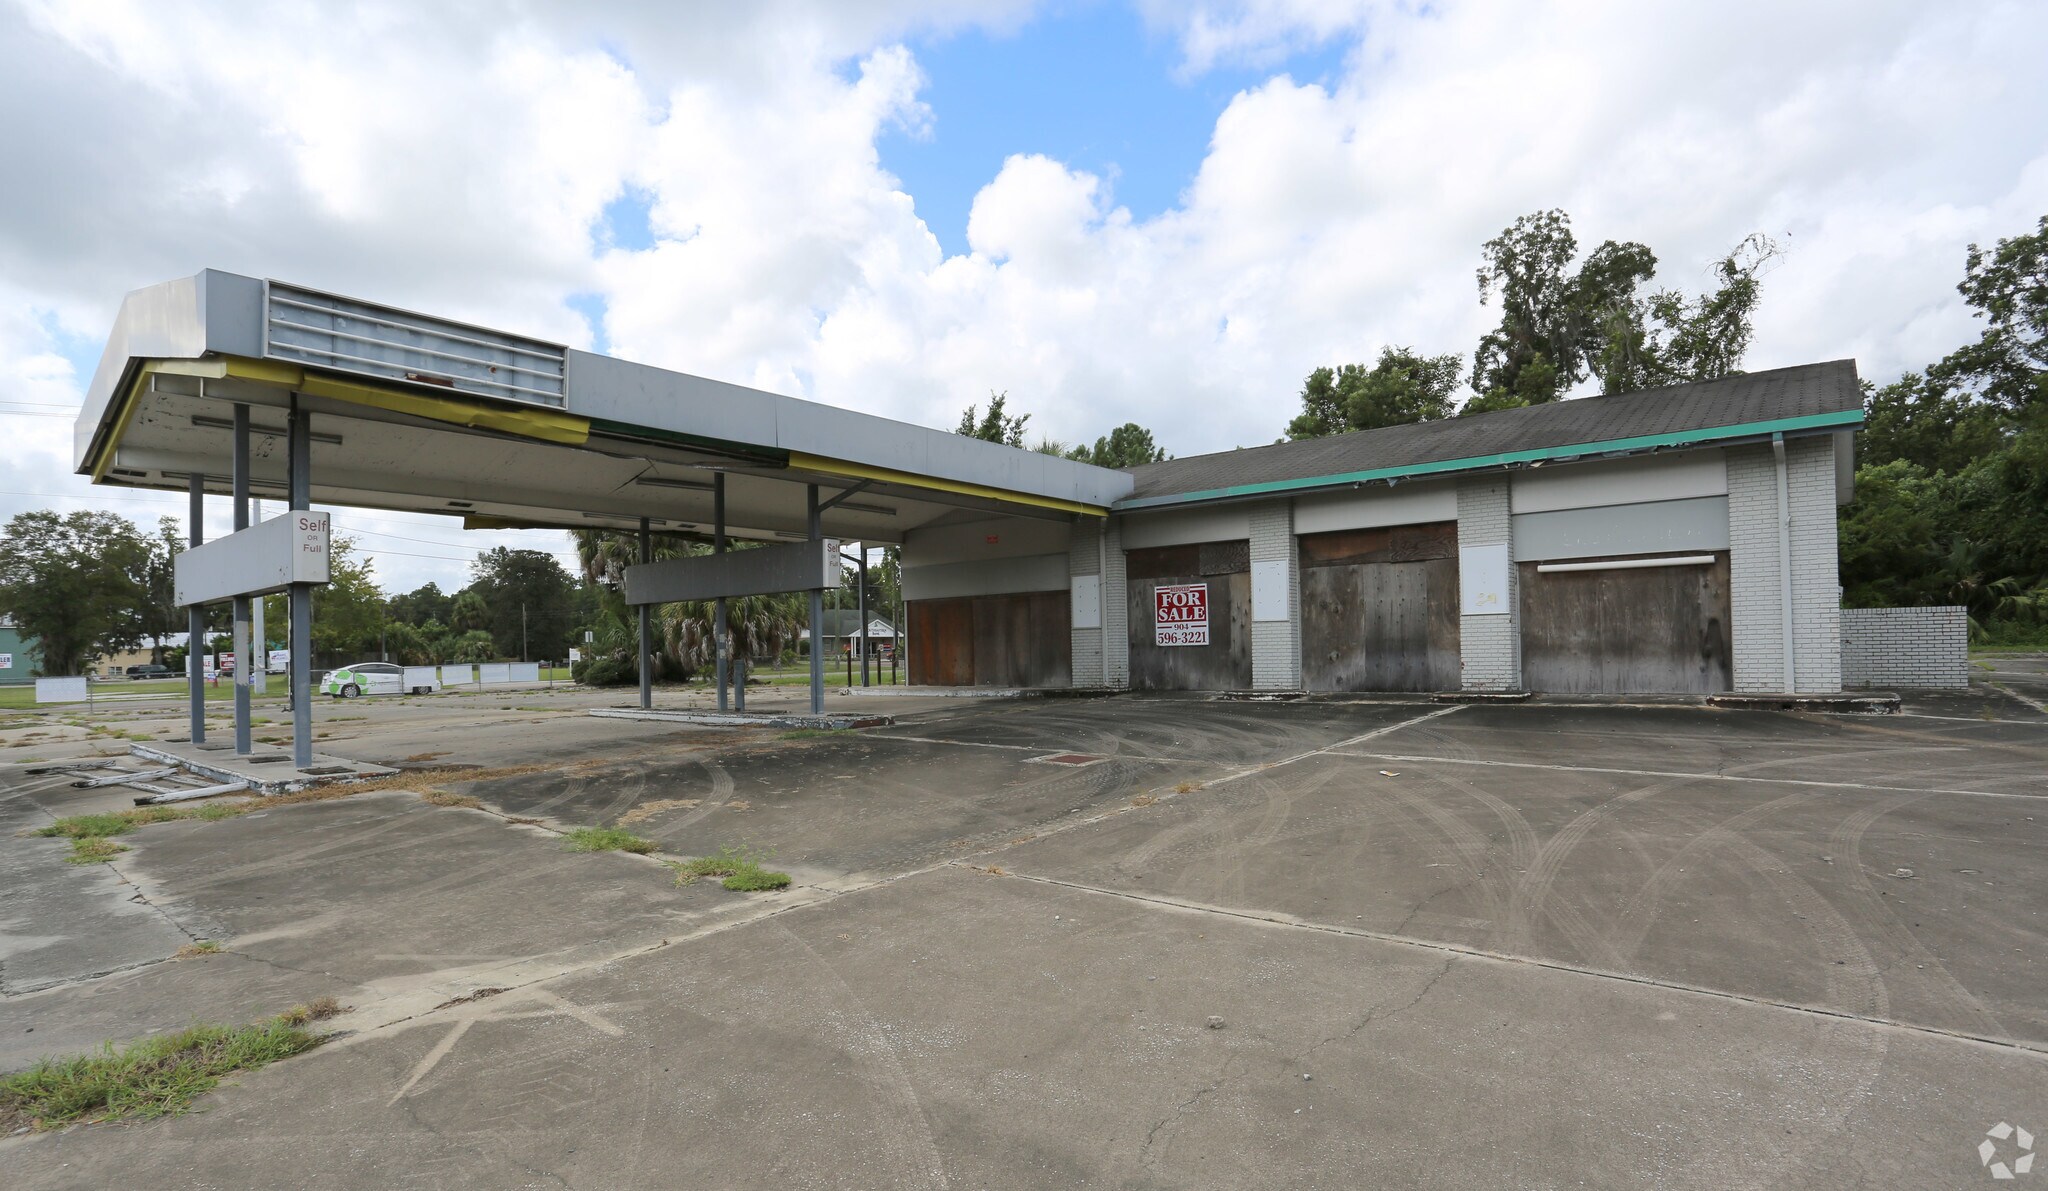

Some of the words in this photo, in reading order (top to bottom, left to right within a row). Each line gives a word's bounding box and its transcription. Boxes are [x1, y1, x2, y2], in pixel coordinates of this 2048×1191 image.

[299, 518, 327, 532] Self
[303, 544, 321, 553] Full
[1161, 592, 1201, 607] FOR
[1158, 606, 1205, 621] SALE
[1157, 631, 1206, 644] 596-3221
